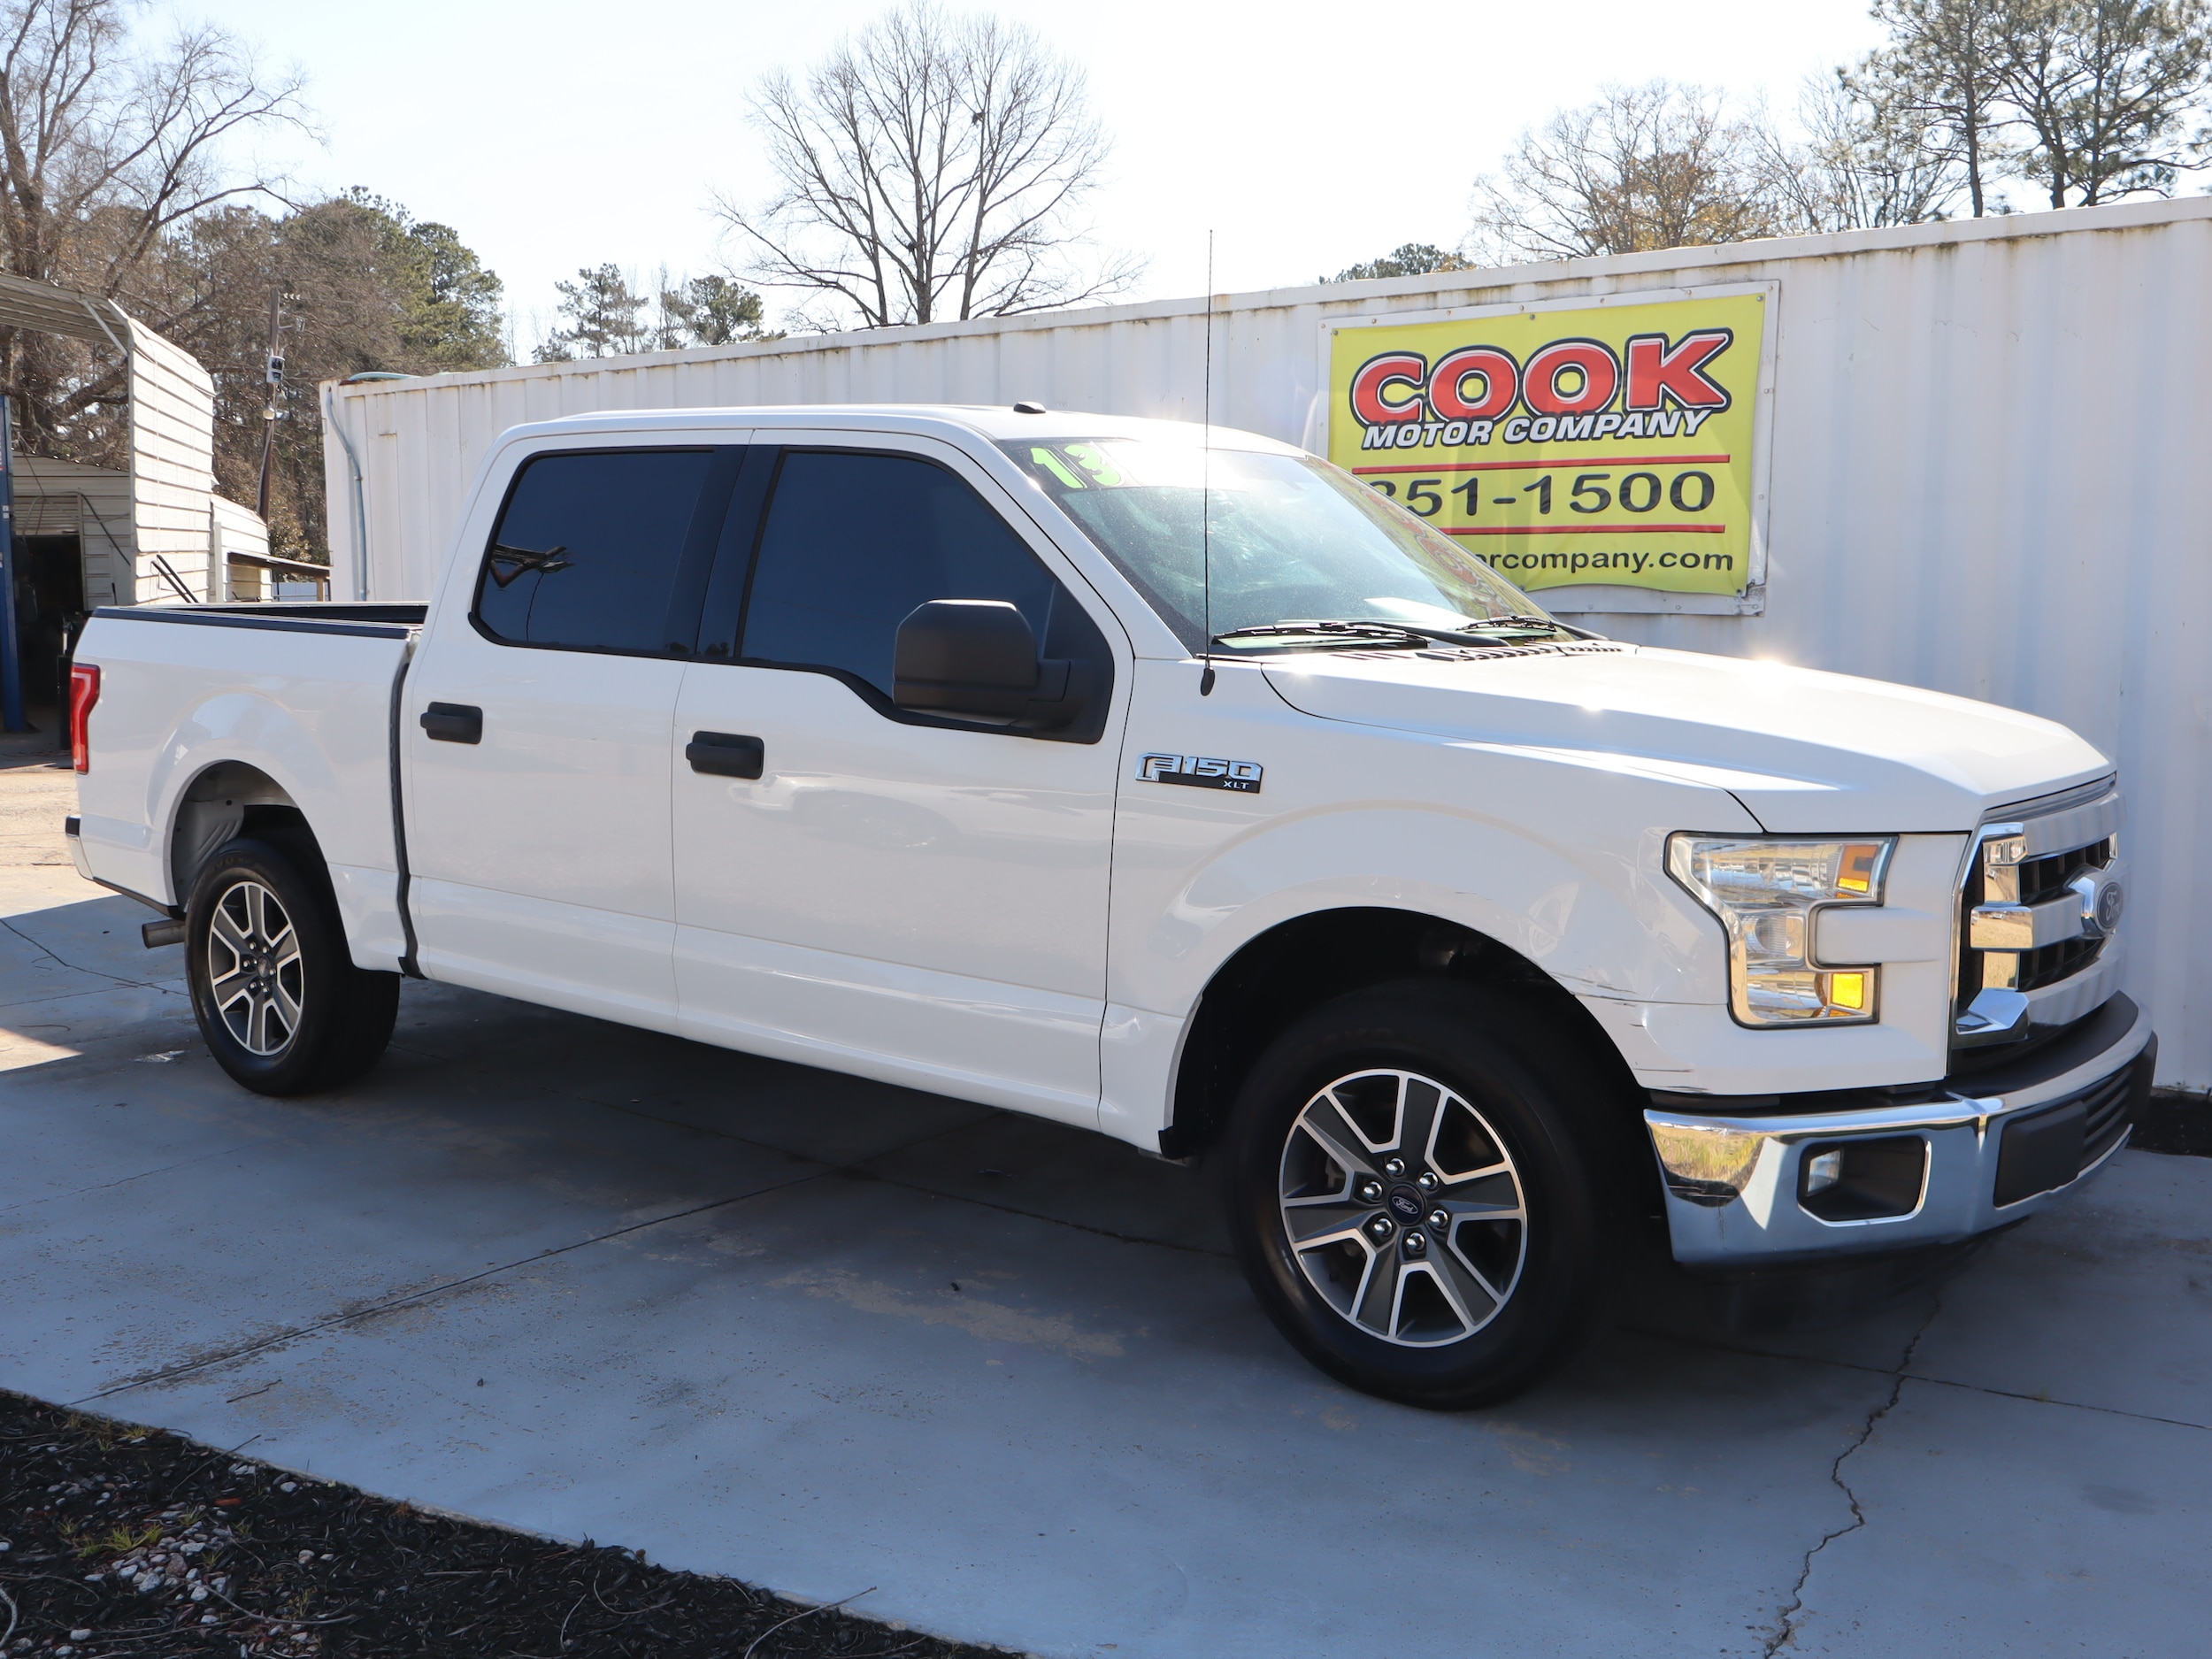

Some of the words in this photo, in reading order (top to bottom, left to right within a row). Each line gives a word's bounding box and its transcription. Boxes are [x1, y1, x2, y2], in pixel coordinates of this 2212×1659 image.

[1350, 327, 1733, 428] COOK
[1362, 419, 1494, 449] MOTOR
[1503, 409, 1713, 442] COMPANY
[1030, 444, 1122, 489] 13
[1224, 780, 1249, 790] XLT
